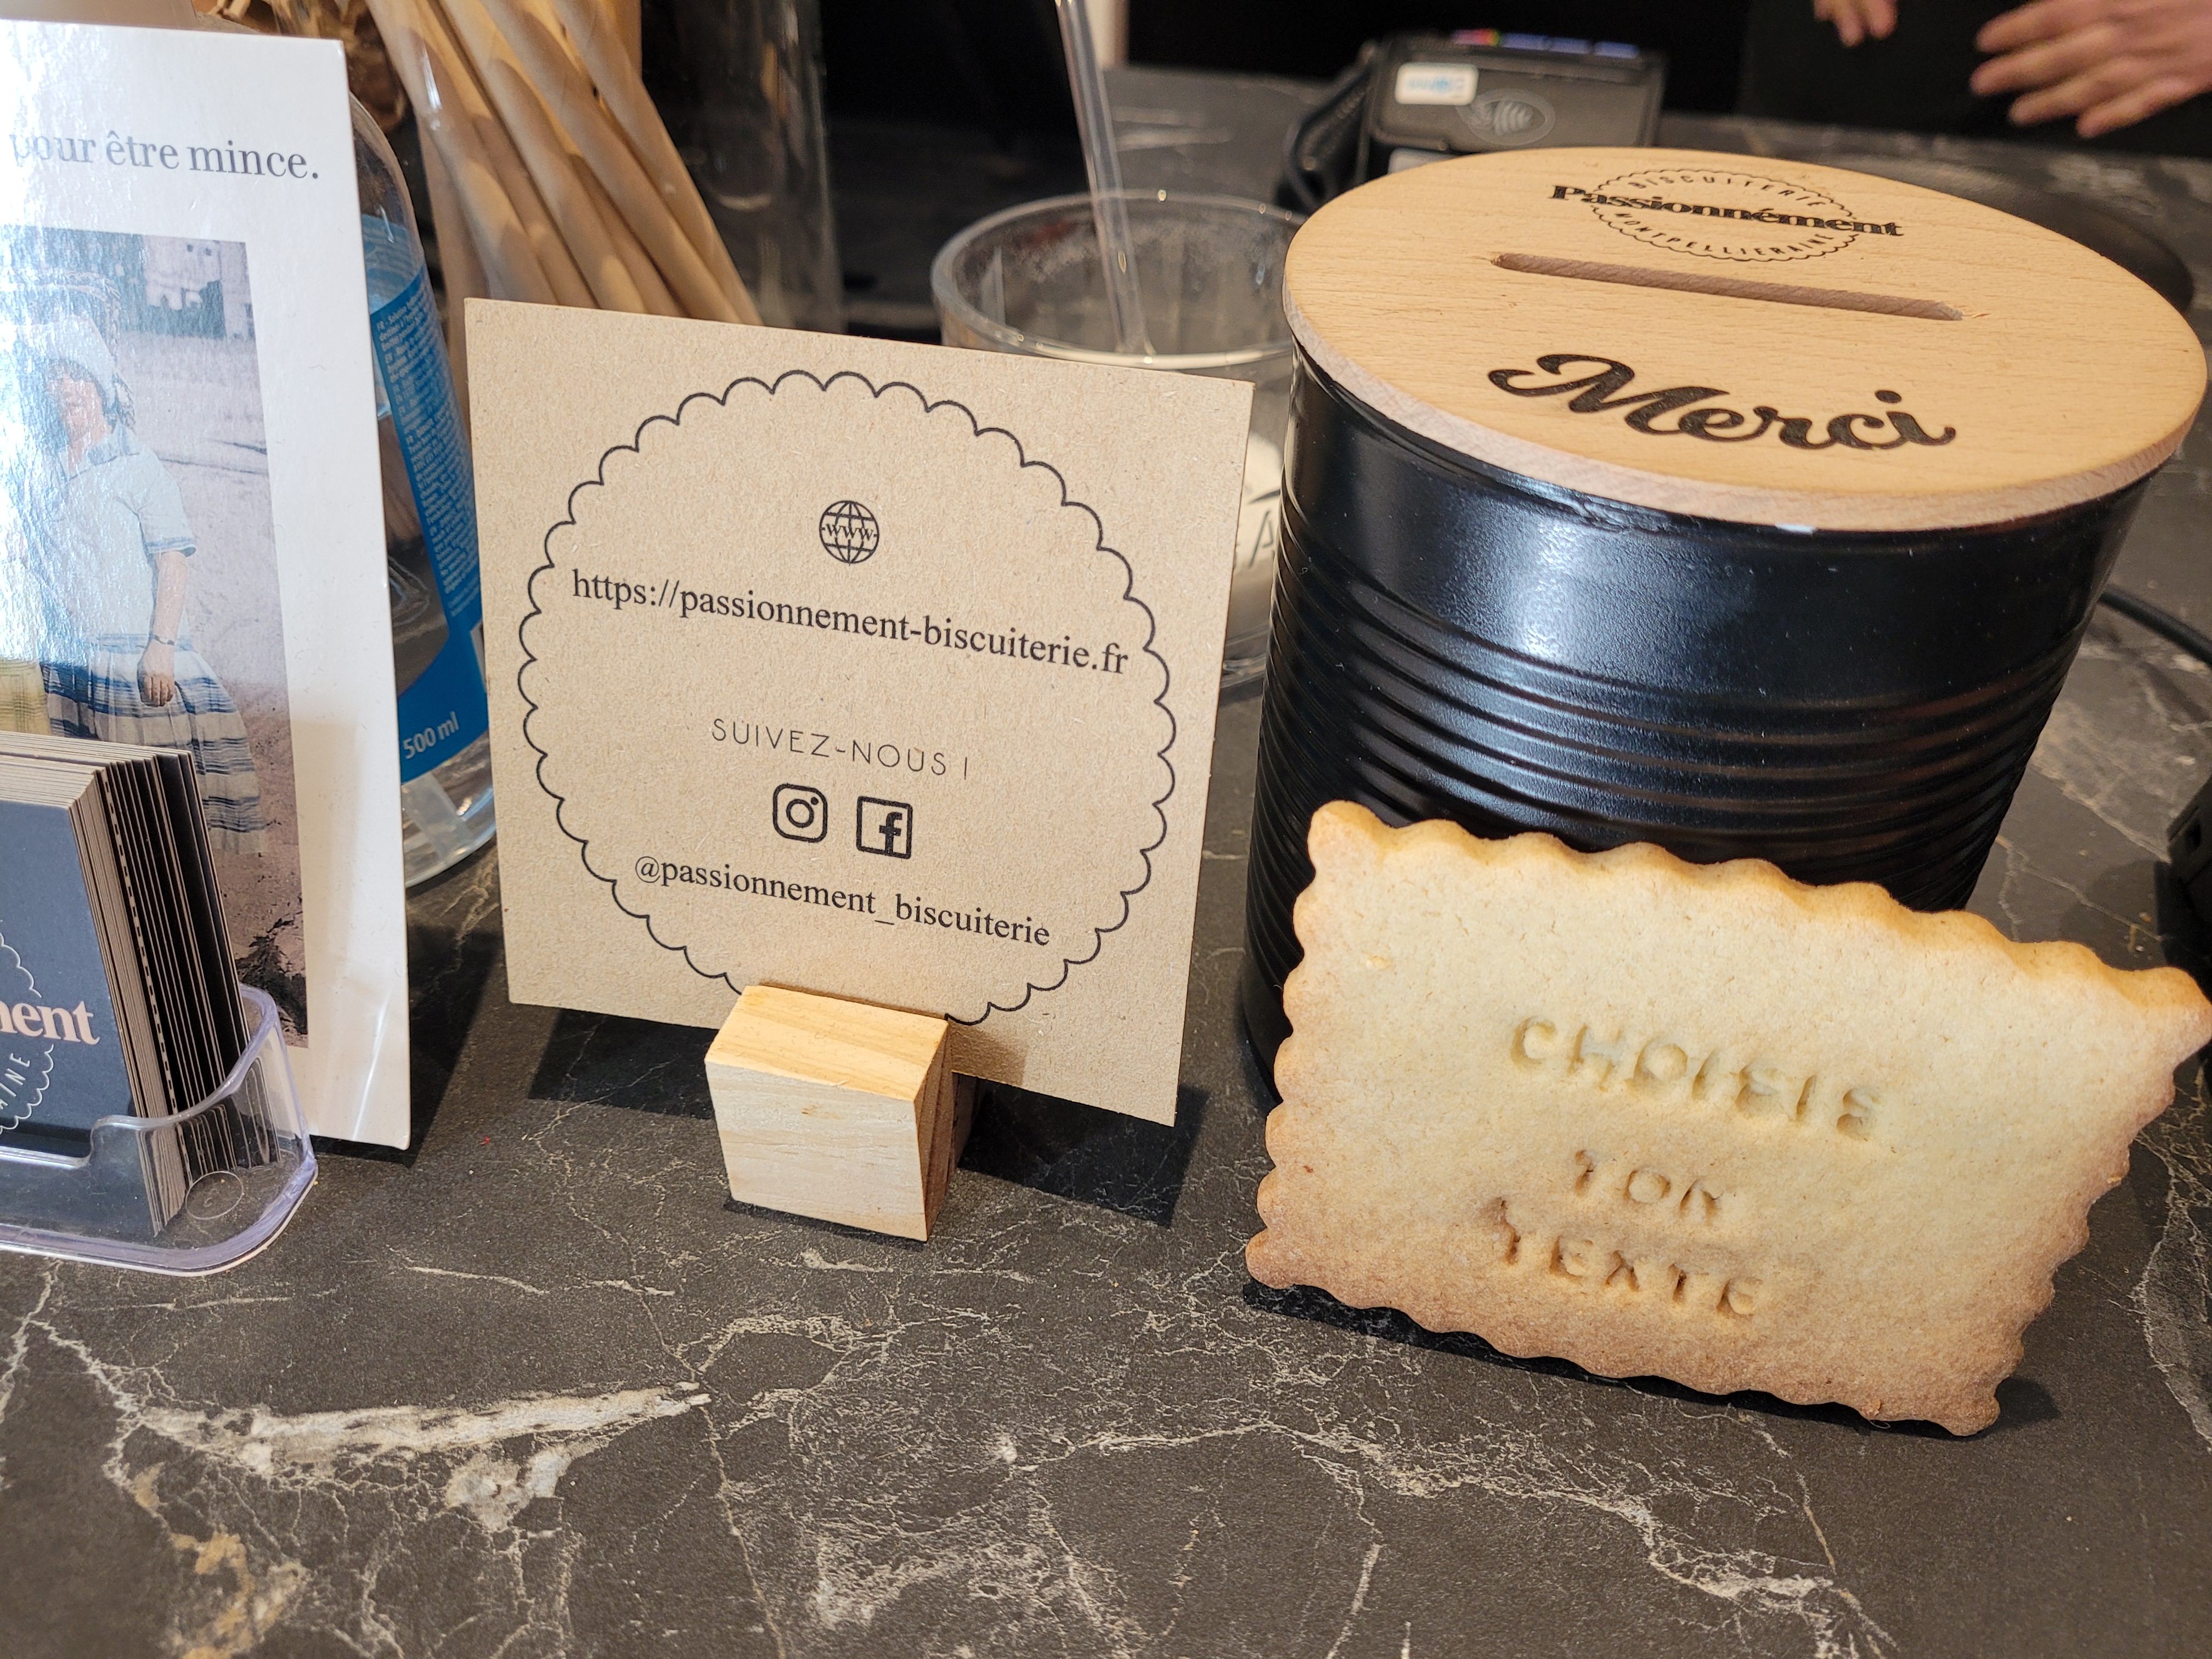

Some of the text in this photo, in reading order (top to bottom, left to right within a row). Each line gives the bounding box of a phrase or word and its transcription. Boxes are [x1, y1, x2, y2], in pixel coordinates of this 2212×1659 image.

[9, 130, 319, 179] pour être mince.
[1547, 185, 1904, 237] Passionnément
[1487, 353, 1956, 450] Merci
[572, 568, 1130, 675] https://passionnement-biscuiterie.fr
[403, 710, 460, 759] 500 ml
[712, 718, 946, 775] SUIVEZ-NOUS
[634, 856, 1051, 947] @passionnement_biscuiterie
